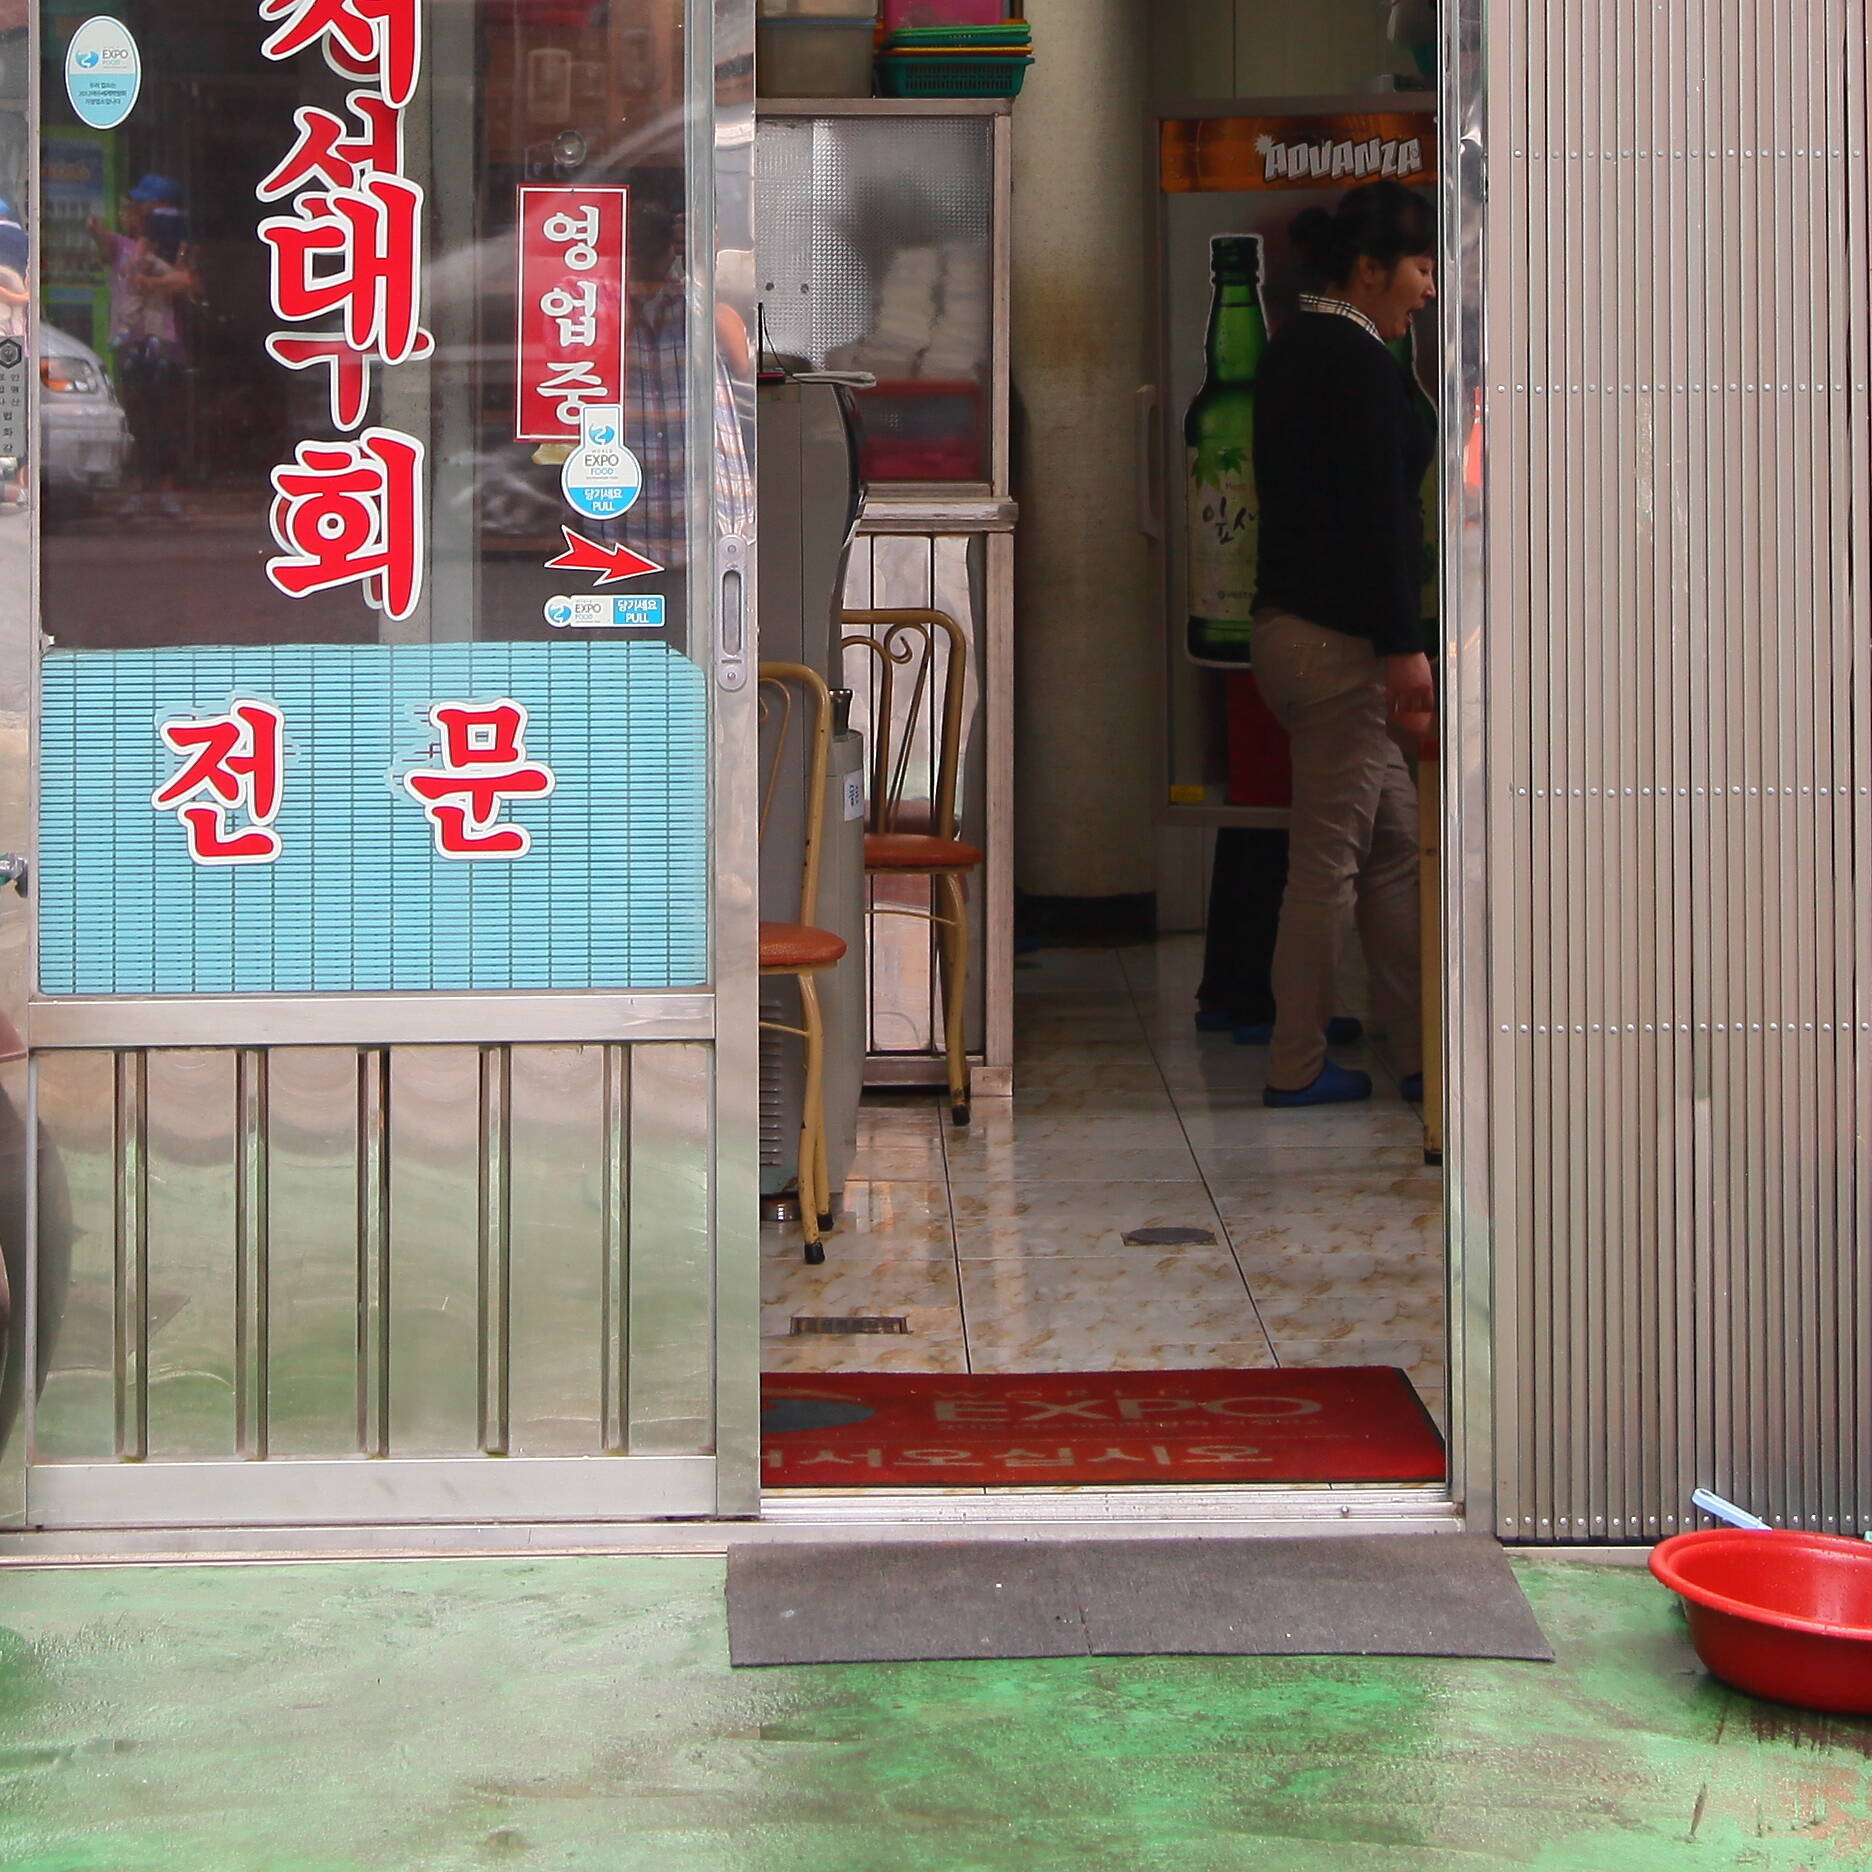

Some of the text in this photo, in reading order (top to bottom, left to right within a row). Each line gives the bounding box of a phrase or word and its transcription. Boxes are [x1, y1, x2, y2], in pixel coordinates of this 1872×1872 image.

[102, 49, 129, 59] EXPO
[1264, 137, 1423, 182] ADVANZA
[536, 204, 609, 426] 영업중
[584, 454, 619, 467] EXPO
[584, 488, 623, 501] 당기세요
[592, 501, 615, 511] PULL
[575, 603, 602, 613] EXPO
[617, 599, 658, 612] 당기세요
[626, 612, 649, 623] PULL
[934, 1395, 1323, 1422] EXPO
